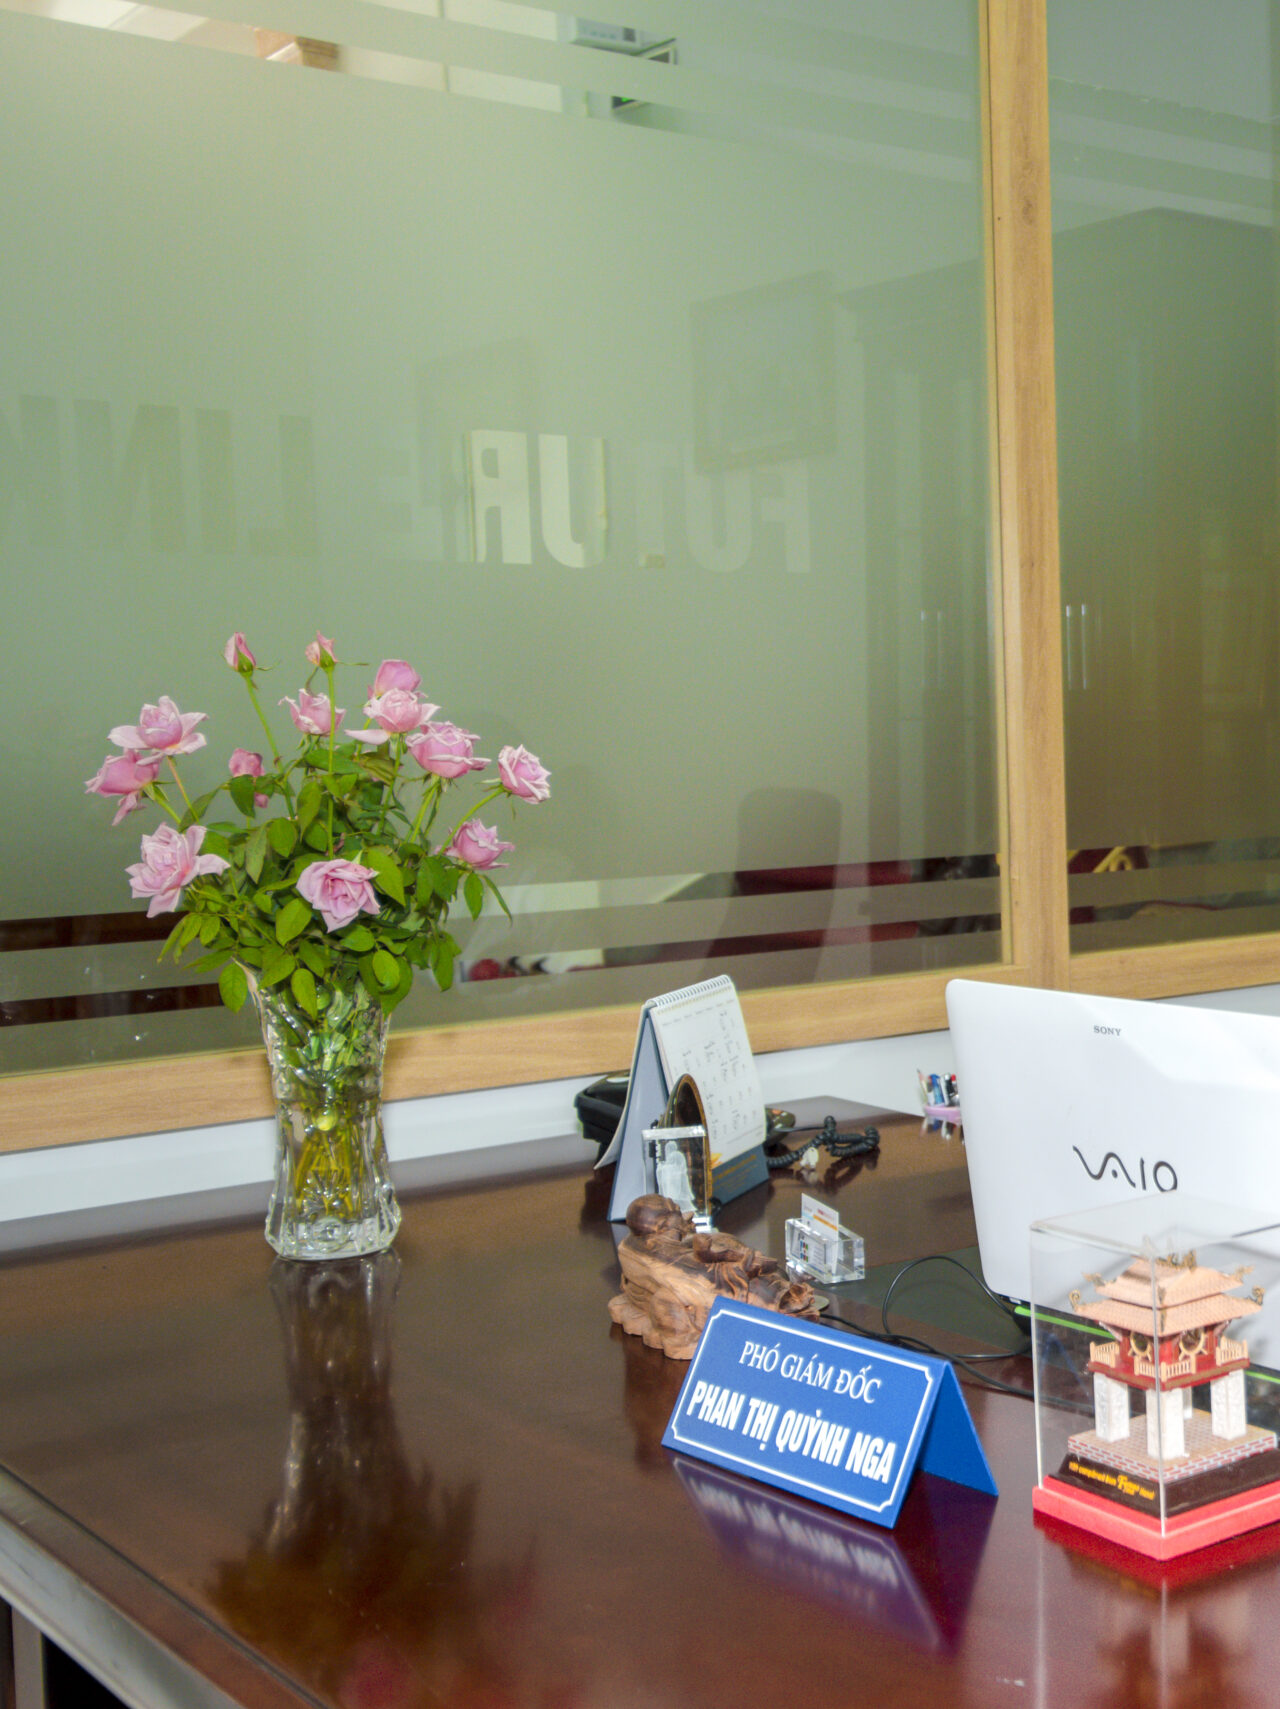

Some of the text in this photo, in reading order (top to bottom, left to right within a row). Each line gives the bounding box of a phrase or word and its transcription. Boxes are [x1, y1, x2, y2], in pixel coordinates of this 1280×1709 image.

[1093, 1025, 1122, 1036] SONY
[1072, 1145, 1178, 1193] VAIO
[739, 1341, 882, 1404] PHÓ GIÁM ĐỐC
[686, 1380, 897, 1485] PHAN THỊ QUỲNH NGA
